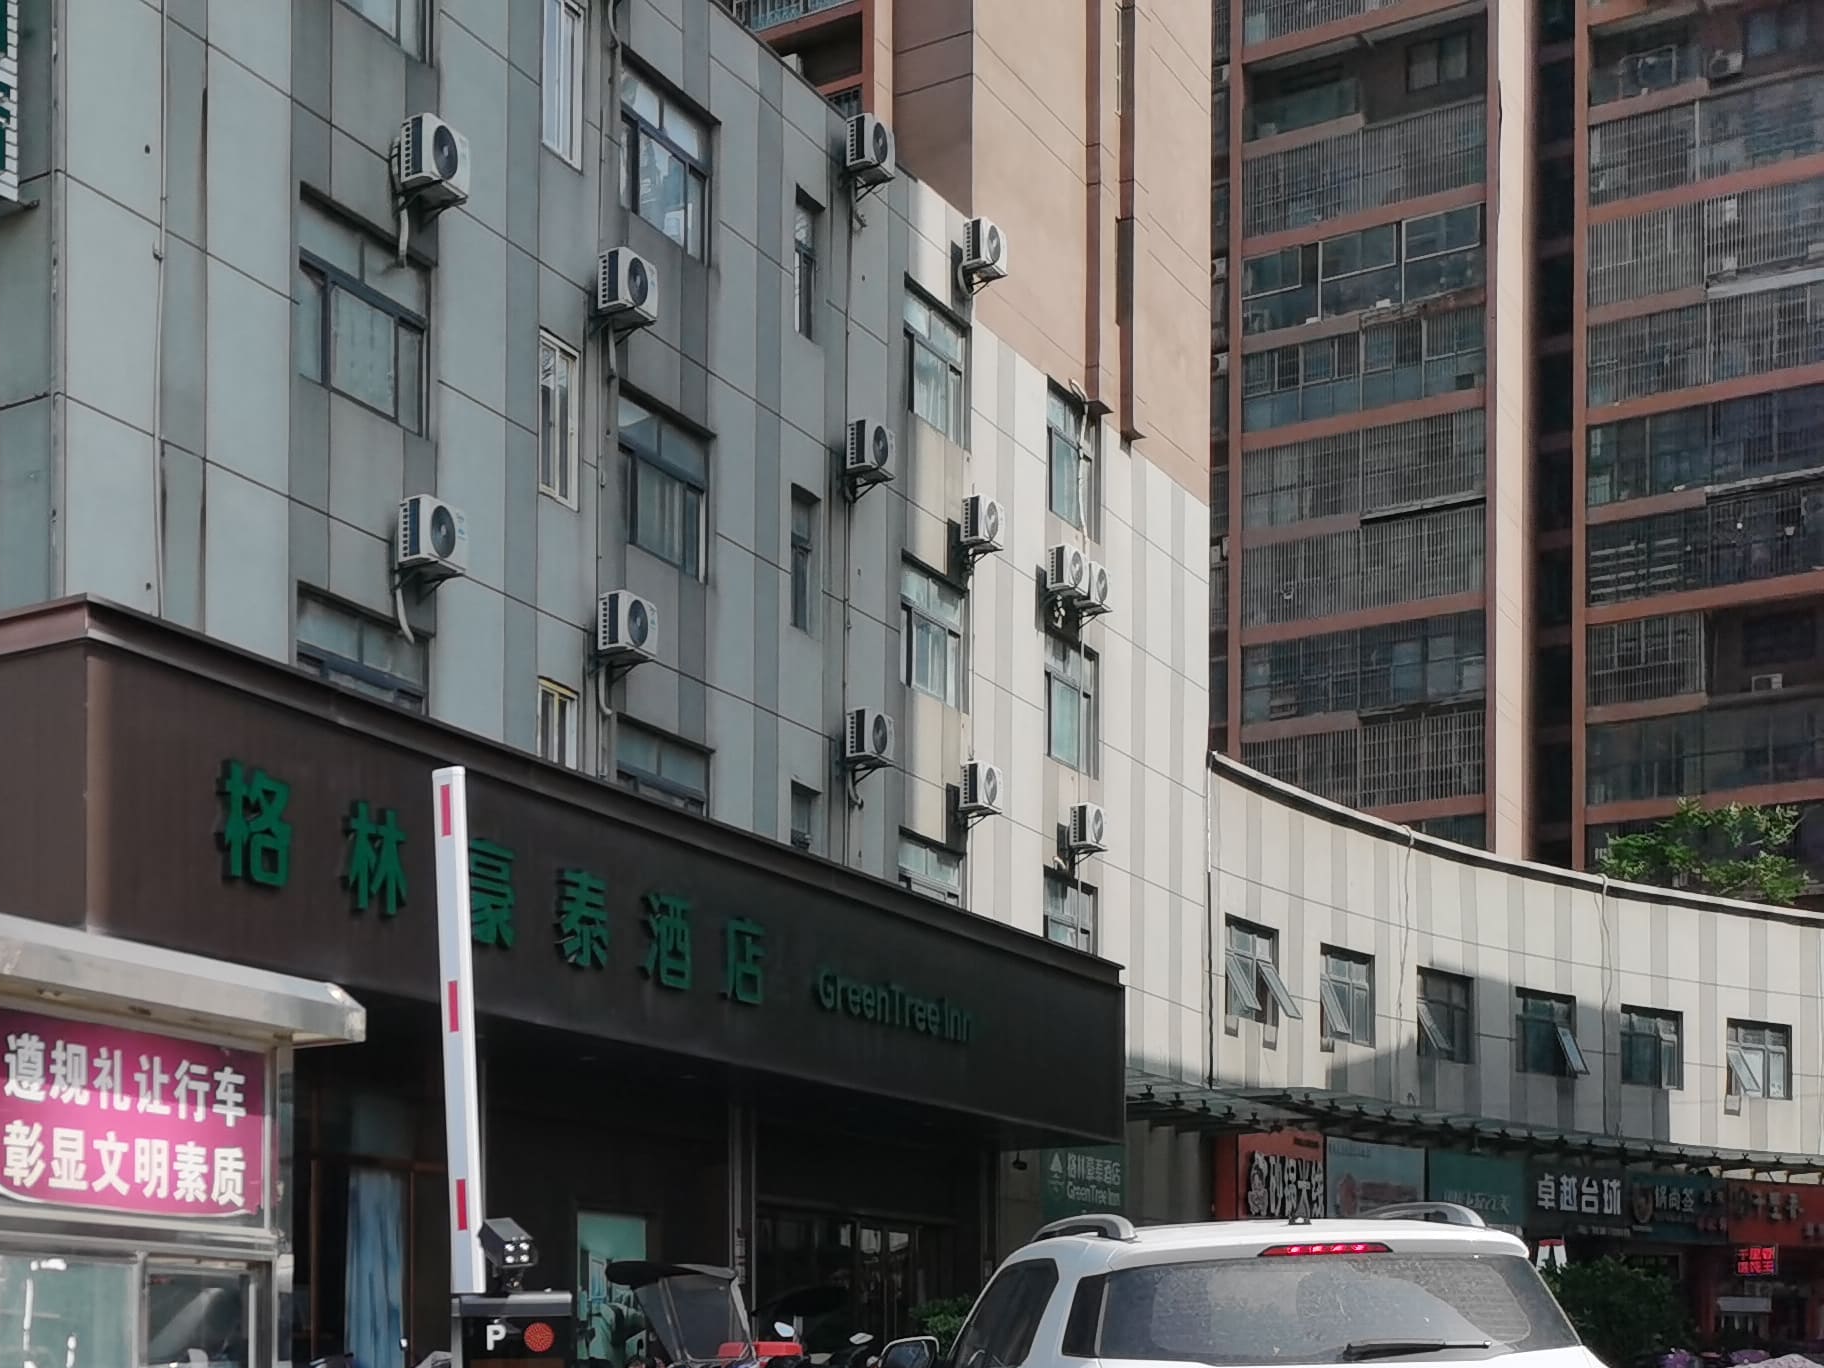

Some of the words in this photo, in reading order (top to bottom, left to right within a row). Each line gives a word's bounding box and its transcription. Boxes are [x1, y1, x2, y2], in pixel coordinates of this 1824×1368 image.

[217, 757, 766, 1006] 格林豪泰酒店
[818, 967, 940, 1034] GreenTree
[3, 1032, 247, 1128] 遵规礼让行车
[2, 1119, 248, 1208] 彰显文明素质
[1537, 1173, 1623, 1216] 卓越台球
